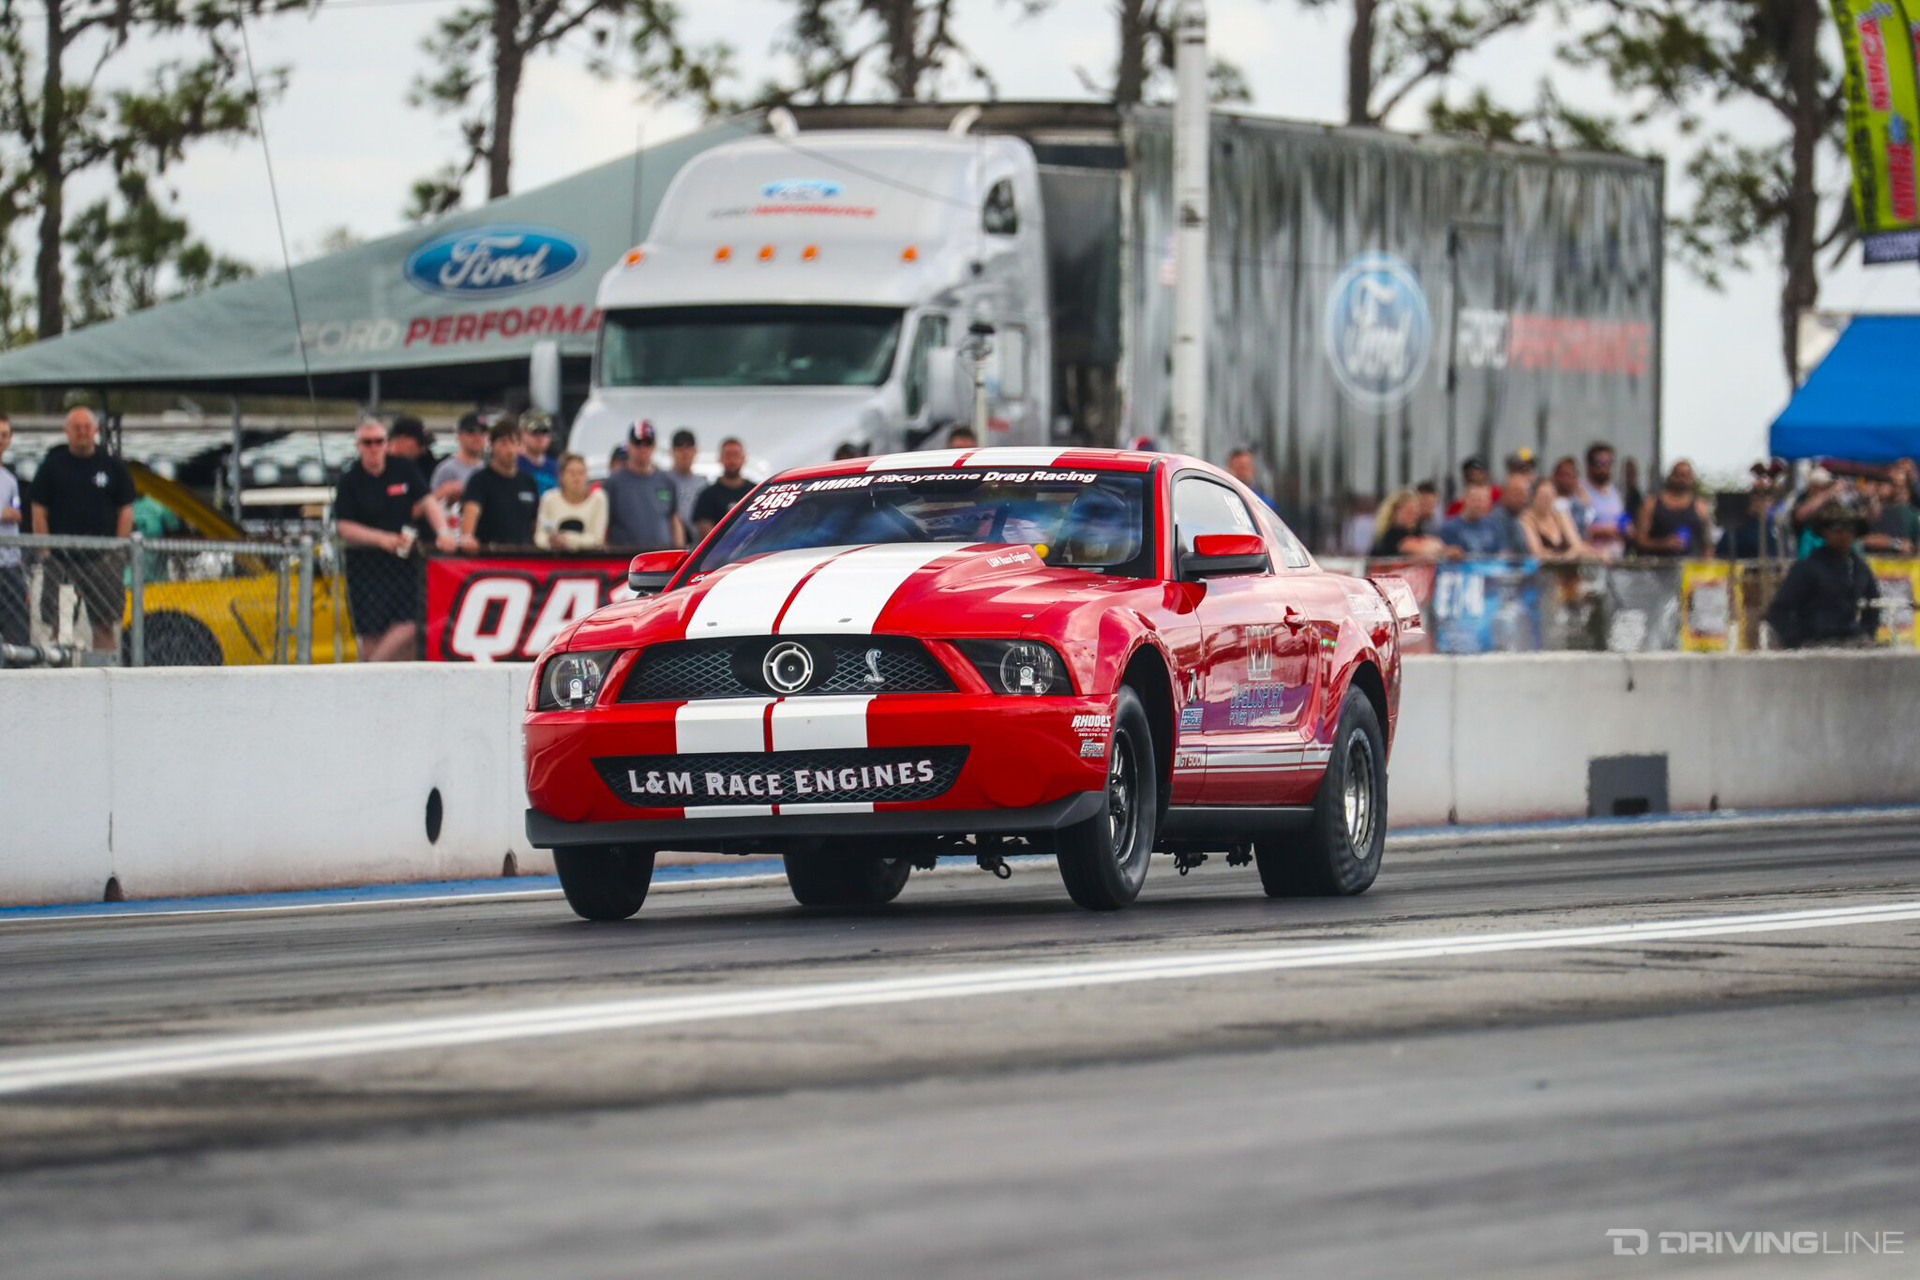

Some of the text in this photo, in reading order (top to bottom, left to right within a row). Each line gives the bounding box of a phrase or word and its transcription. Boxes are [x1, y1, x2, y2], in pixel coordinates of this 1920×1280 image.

[439, 234, 551, 288] Ford
[765, 483, 803, 495] REN
[805, 471, 1097, 492] NMRA Keystone Drag Racing
[746, 491, 802, 512] 2465
[748, 509, 778, 521] S/F
[1180, 717, 1201, 725] TORQUE
[627, 769, 694, 795] L&M
